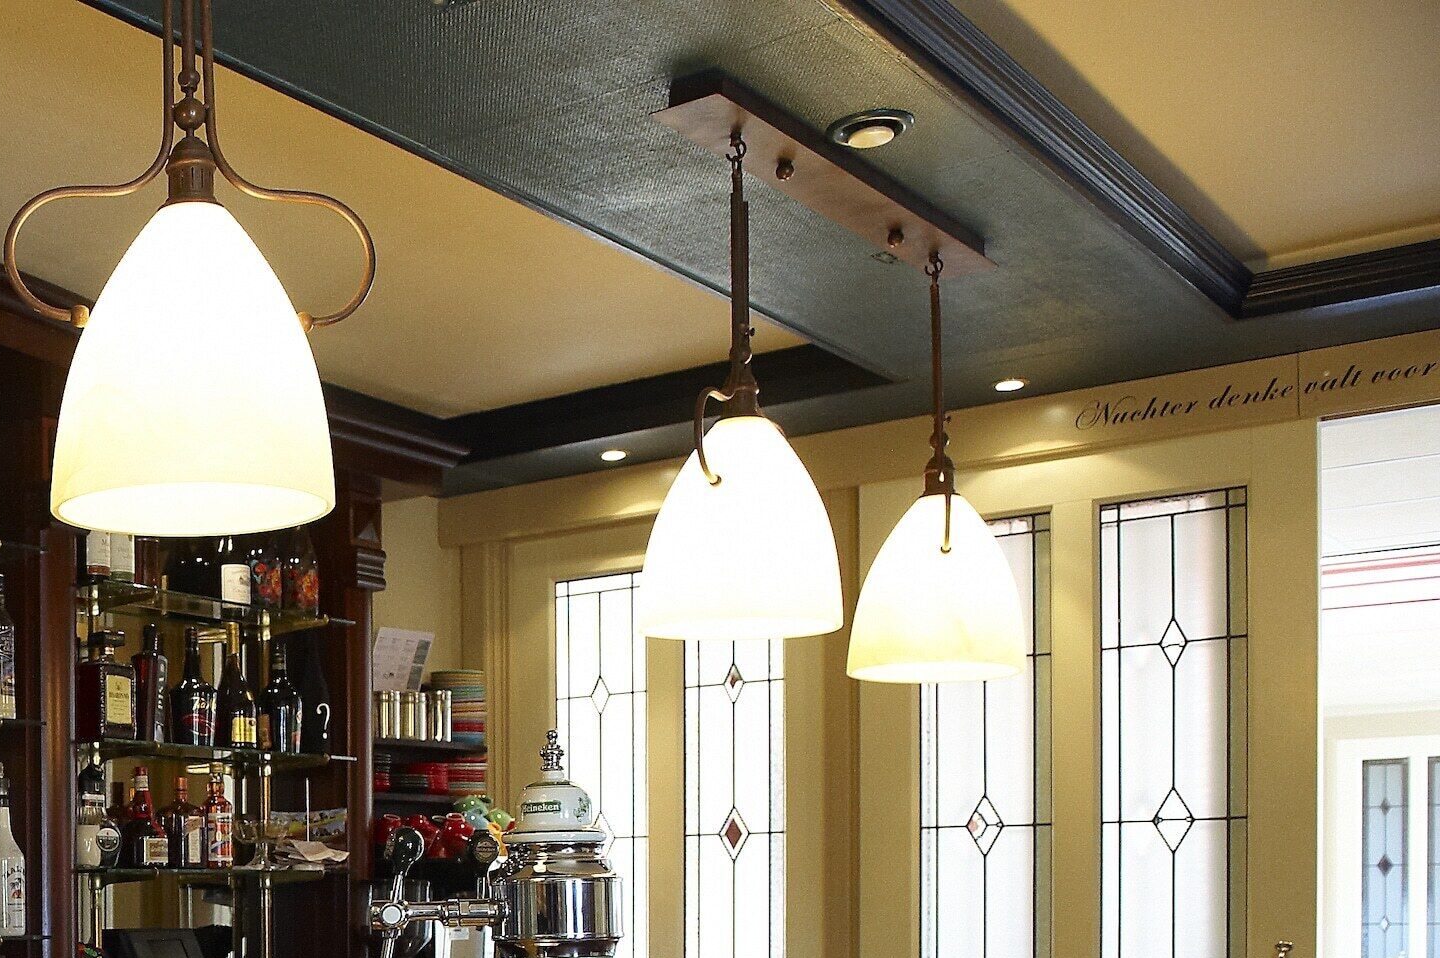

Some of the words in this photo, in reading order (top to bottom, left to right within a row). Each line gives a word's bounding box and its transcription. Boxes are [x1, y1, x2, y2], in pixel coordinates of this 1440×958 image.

[1075, 395, 1198, 431] Nuchter
[1304, 364, 1362, 395] valt
[1371, 361, 1437, 383] voor
